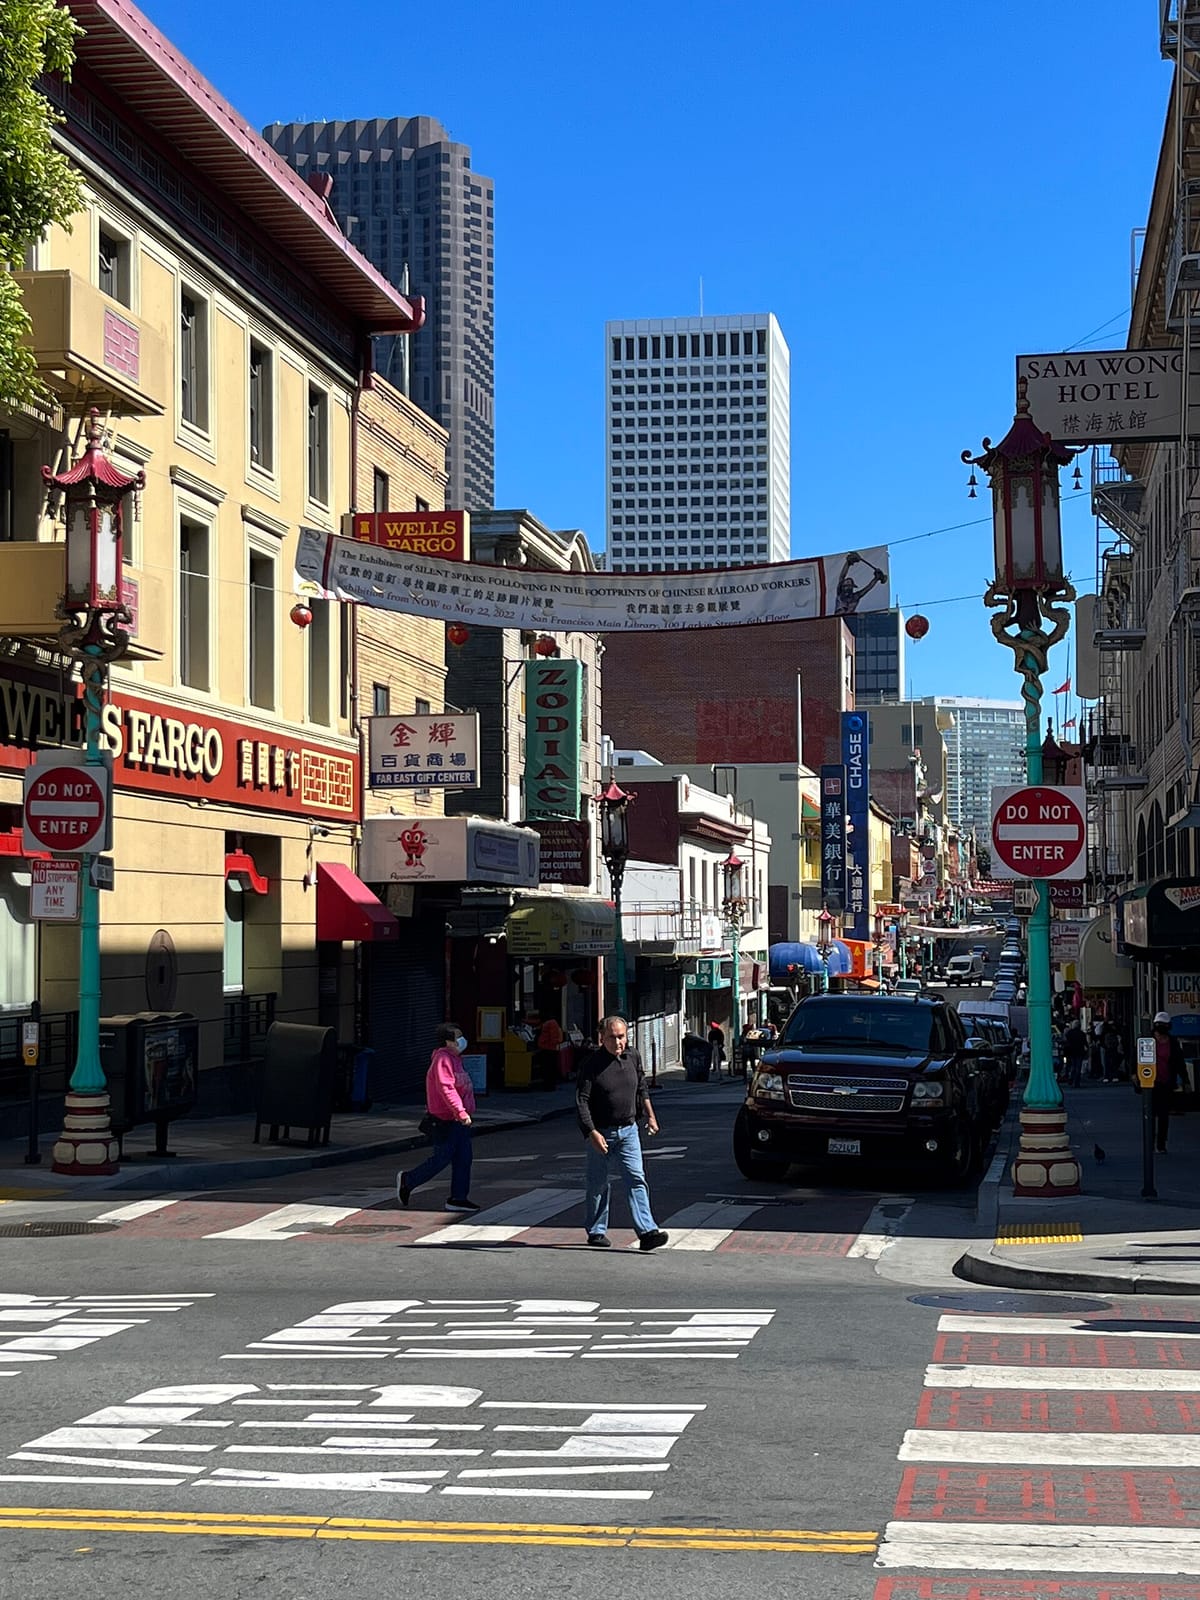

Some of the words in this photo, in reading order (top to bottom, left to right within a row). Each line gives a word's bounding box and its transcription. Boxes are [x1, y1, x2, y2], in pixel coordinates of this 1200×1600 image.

[1027, 359, 1087, 379] SAM
[1058, 381, 1160, 403] HOTEL
[384, 520, 456, 537] WELLS
[386, 537, 456, 553] FARGO
[341, 549, 357, 560] The
[359, 554, 402, 569] Exhibition
[404, 563, 414, 572] of
[415, 565, 450, 577] SILENT
[489, 577, 547, 592] FOLLOWING
[550, 585, 561, 593] IN
[563, 586, 583, 595] THE
[585, 588, 646, 596] FOOTPRINTS
[649, 588, 661, 597] OF
[662, 588, 705, 598] CHINESE
[708, 584, 759, 596] RAILROAD
[761, 577, 811, 589] WORKERS
[343, 583, 385, 599] xhibition
[387, 590, 410, 604] from
[412, 597, 441, 608] NOW
[442, 602, 452, 610] to
[455, 603, 475, 616] May
[493, 609, 515, 619] 2022
[530, 615, 548, 623] San
[551, 617, 594, 627] Francisco
[596, 619, 621, 628] Main
[0, 678, 123, 758] WELS
[128, 709, 223, 777] FARGO
[534, 669, 570, 803] ZODIAC
[380, 753, 467, 768] 百貨商場
[849, 733, 862, 789] CHASE
[376, 773, 393, 784] FAR
[394, 773, 416, 783] EAST
[417, 772, 437, 783] GIFT
[438, 771, 471, 783] CENTER
[38, 783, 58, 797] DO
[64, 783, 93, 797] NOT
[1006, 805, 1029, 820] DO
[1039, 805, 1071, 820] NOT
[39, 820, 90, 834] ENTER
[825, 801, 843, 881] 華美銀行
[553, 850, 582, 858] HISTORY
[1012, 845, 1065, 860] ENTER
[35, 861, 76, 869] TOW-AWAY
[553, 861, 582, 869] CULTURE
[33, 869, 46, 882] NO
[46, 885, 65, 895] ANY
[851, 863, 863, 913] 大通銀行
[44, 896, 65, 907] TIME
